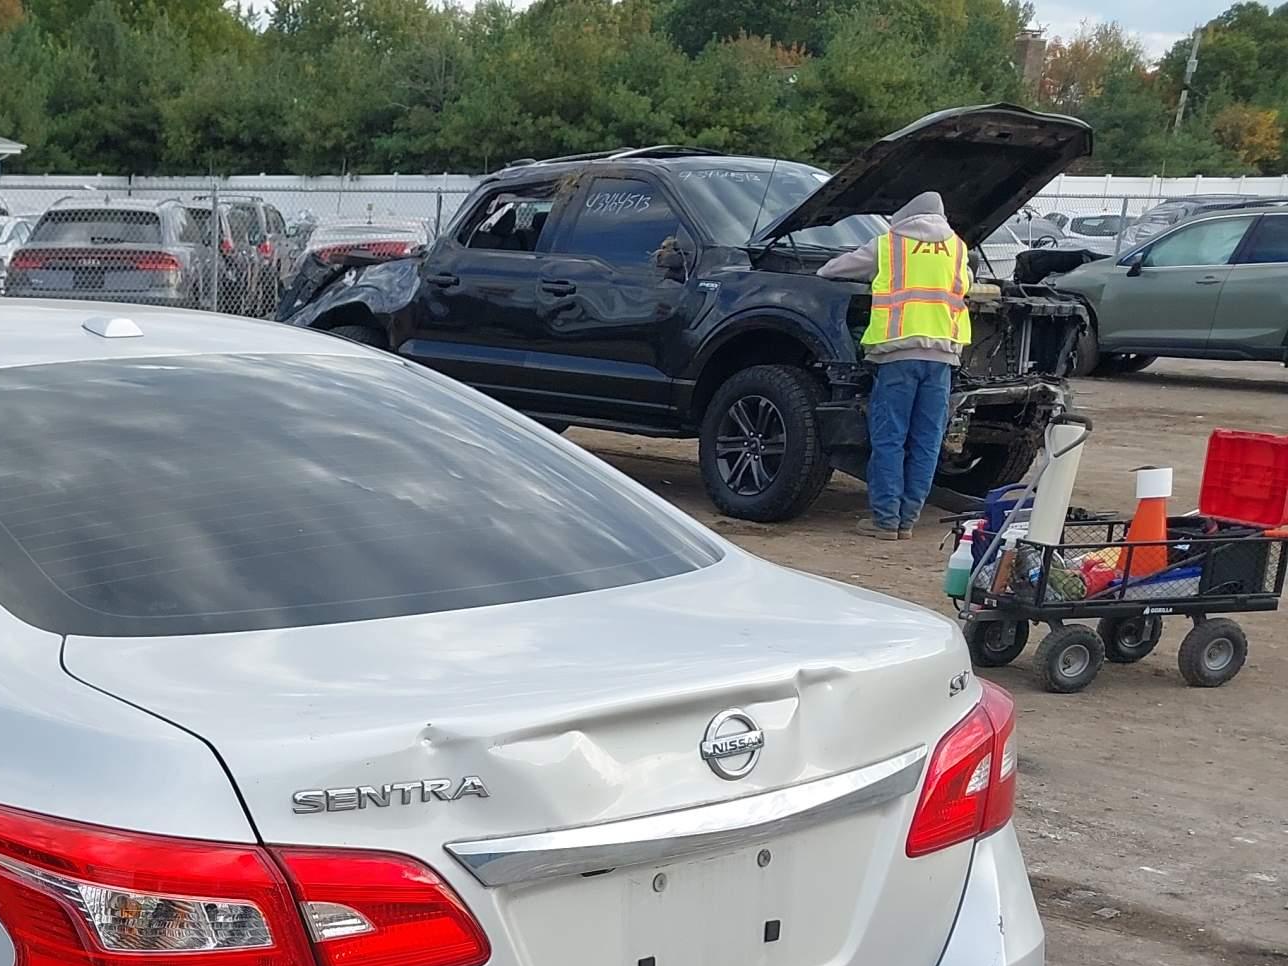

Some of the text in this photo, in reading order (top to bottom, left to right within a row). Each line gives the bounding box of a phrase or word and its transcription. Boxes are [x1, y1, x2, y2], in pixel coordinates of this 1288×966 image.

[949, 670, 970, 697] SV
[711, 734, 763, 755] NISSAN
[292, 775, 491, 815] SENTRA
